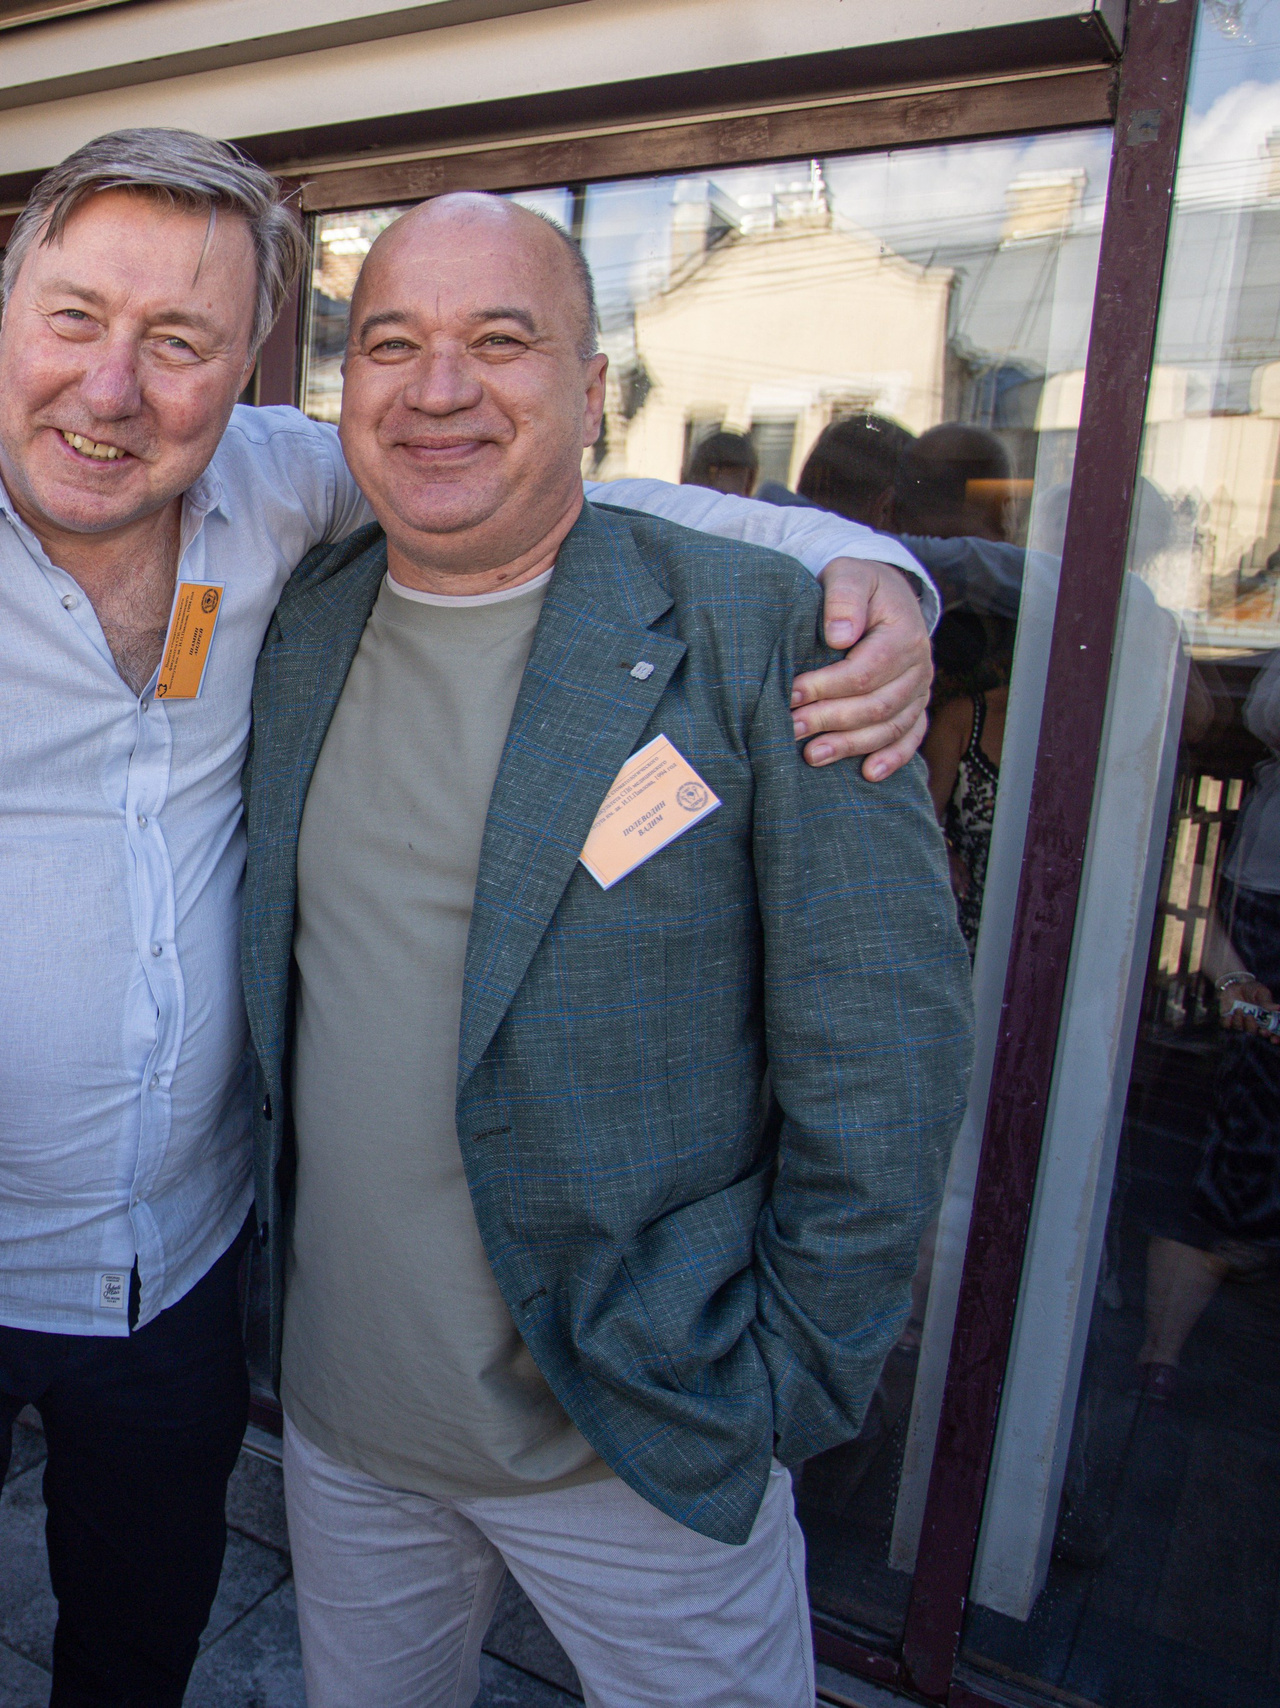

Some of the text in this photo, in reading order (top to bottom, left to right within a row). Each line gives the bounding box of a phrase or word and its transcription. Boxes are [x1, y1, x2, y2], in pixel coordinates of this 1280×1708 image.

[656, 769, 667, 780] 1994
[623, 800, 666, 836] ПОЛЕВОДИН
[638, 814, 664, 836] ВАДИМ
